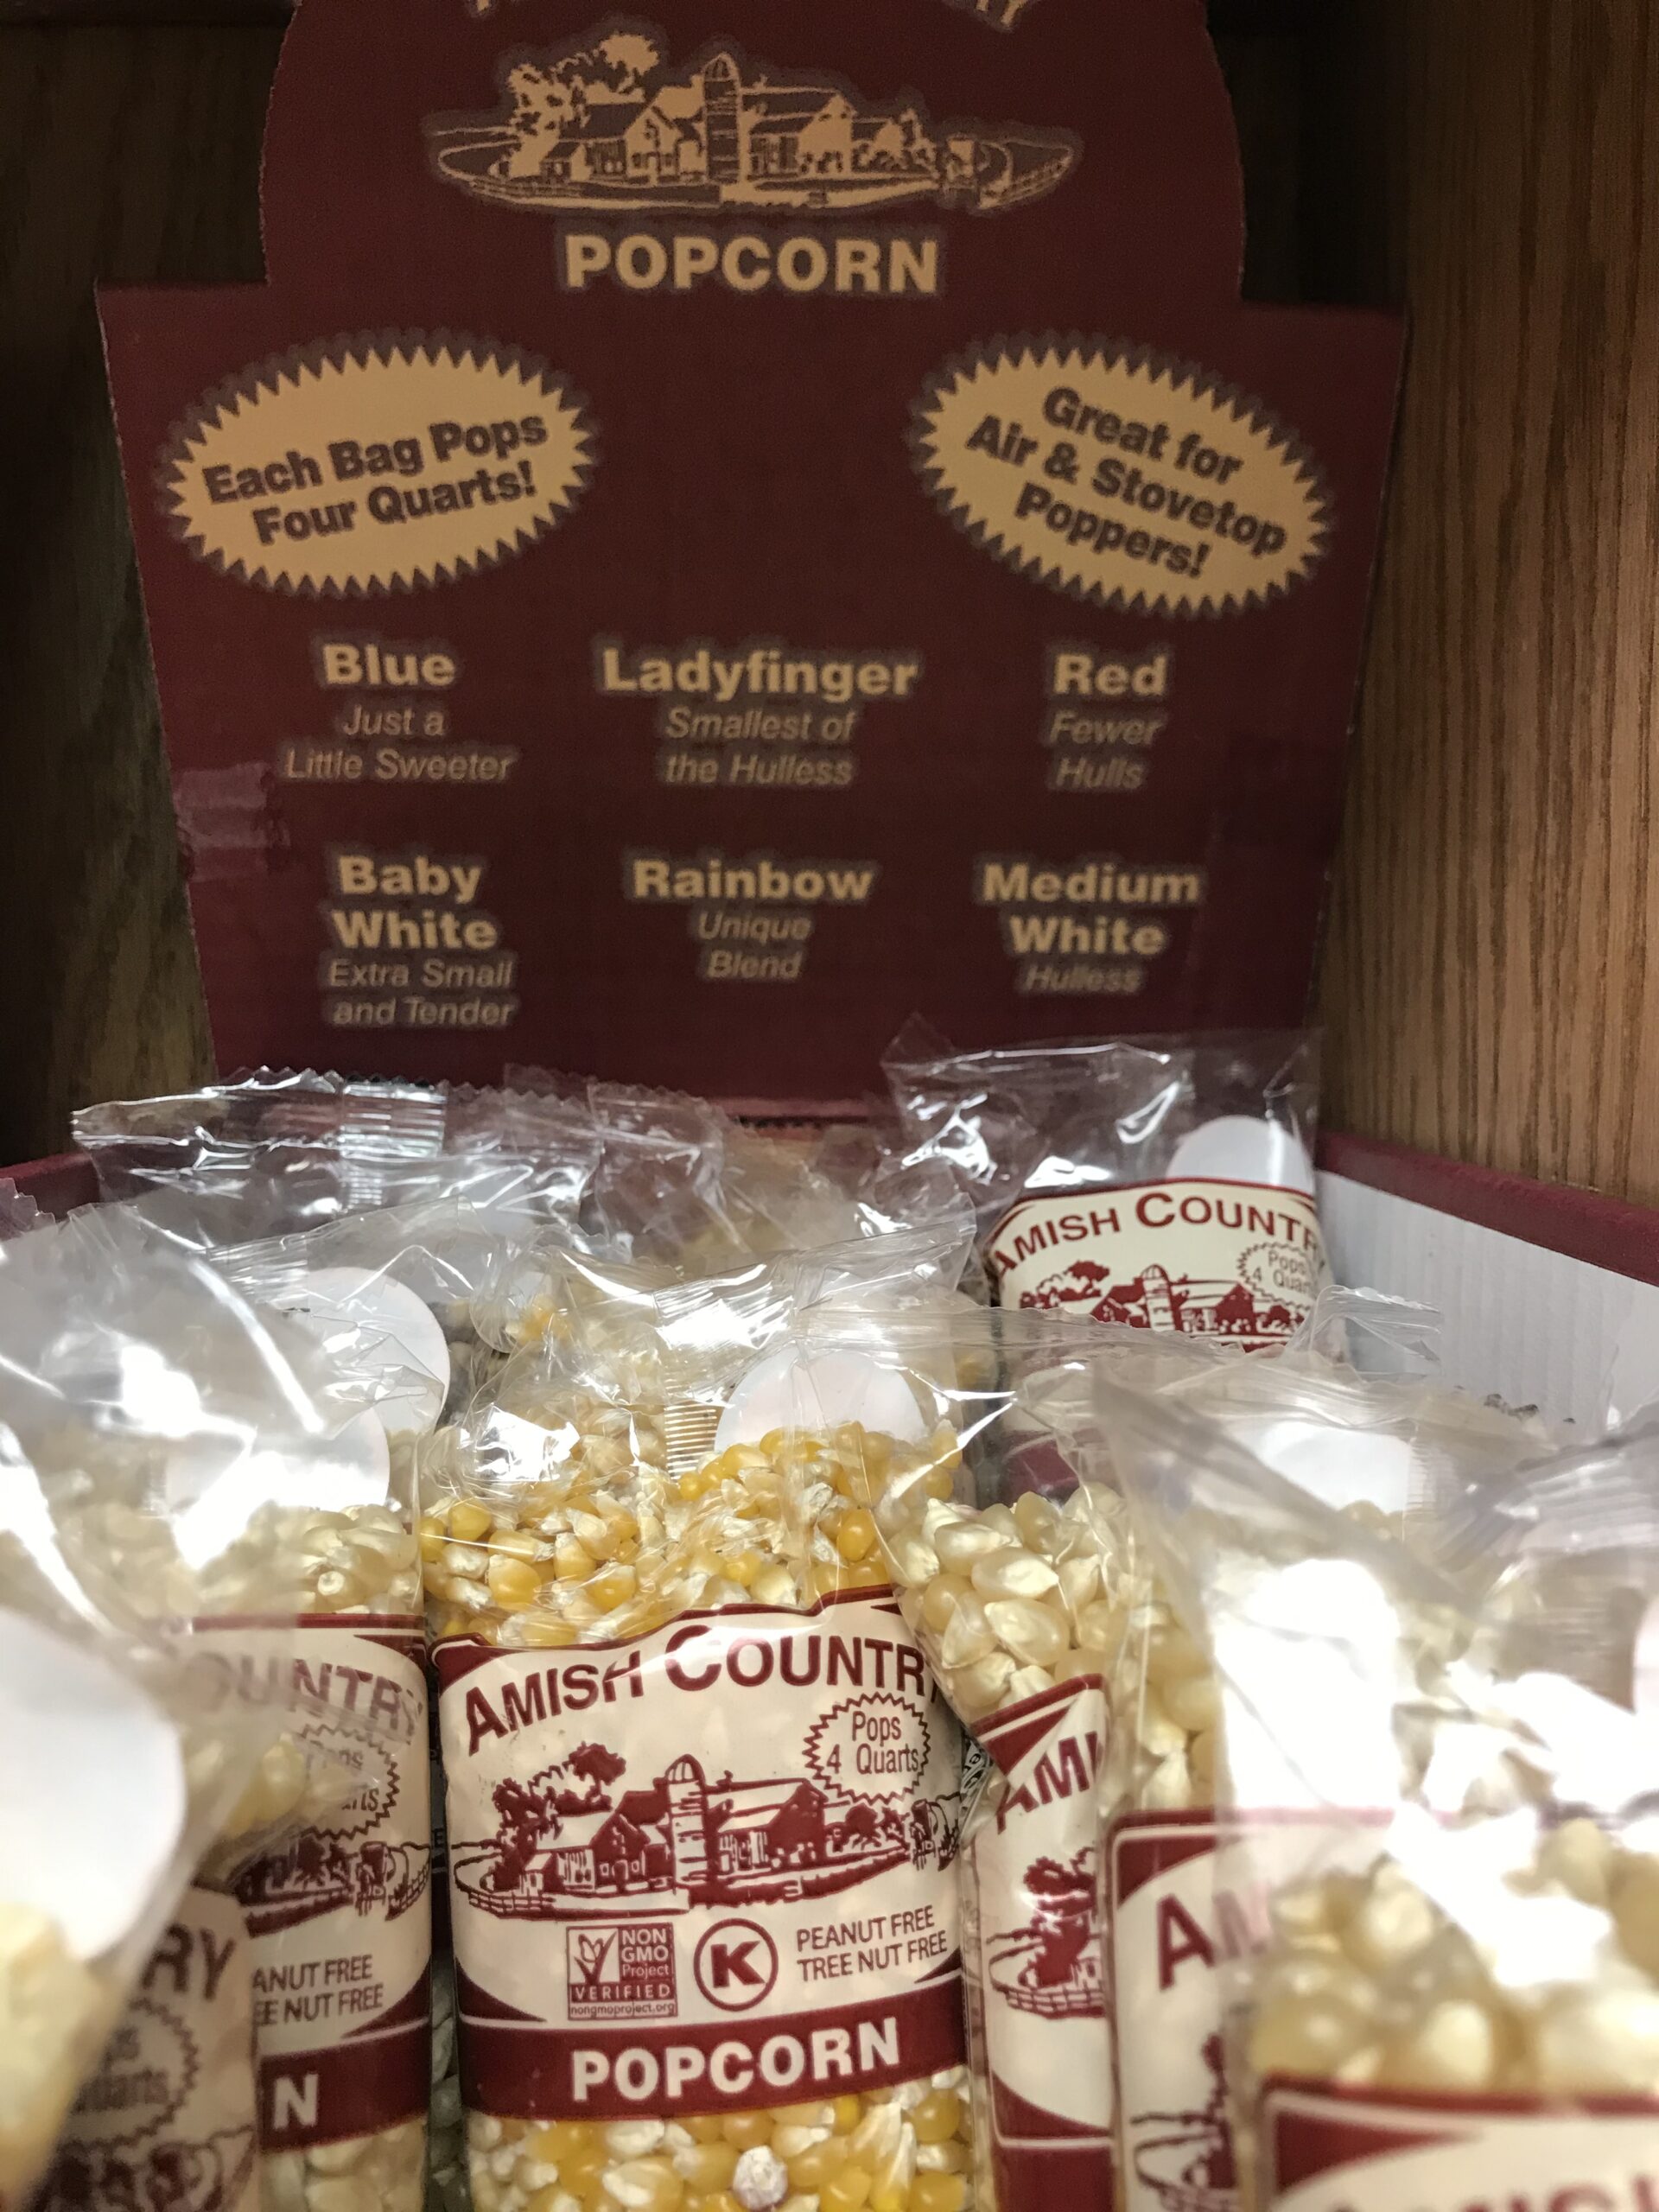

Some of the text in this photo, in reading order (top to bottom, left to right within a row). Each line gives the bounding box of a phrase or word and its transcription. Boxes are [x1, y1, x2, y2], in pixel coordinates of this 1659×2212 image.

[566, 234, 938, 294] POPCORN
[1042, 386, 1243, 486] Great for
[201, 415, 550, 505] Each Bag Pops
[253, 461, 537, 545] Four Quarts!
[964, 414, 1287, 559] Air & Stovetop
[1014, 481, 1212, 579] Poppers!
[322, 643, 456, 686] Blue
[603, 648, 919, 703] Ladyfinger
[1053, 653, 1167, 696] Red
[343, 704, 447, 736] Just a
[666, 706, 859, 742] Smallest of
[1048, 709, 1167, 746] Fewer
[284, 747, 514, 781] Little Sweeter
[665, 754, 854, 785] the Hulless
[1056, 757, 1145, 790] Hulls
[338, 855, 482, 904] Baby
[632, 858, 875, 900] Rainbow
[982, 863, 1200, 904] Medium
[331, 910, 499, 950] White
[698, 911, 812, 944] Unique
[1009, 914, 1166, 955] White
[327, 958, 513, 989] Extra Small
[707, 949, 804, 981] Blend
[1024, 963, 1142, 995] Hulless
[332, 996, 516, 1027] and Tender
[990, 1192, 1325, 1279] AMISH COUNTR
[1252, 1266, 1263, 1282] 4
[466, 1649, 644, 1758] AMISH
[852, 1710, 901, 1747] Pops
[826, 1742, 919, 1776] 4 Quarts
[621, 1928, 668, 1945] NON
[797, 1904, 935, 1953] PEANUT FREE
[251, 1961, 321, 1993] ANUT
[323, 1954, 373, 1986] FREE
[621, 1945, 670, 1963] GMO
[622, 1963, 670, 1980] Project
[710, 1940, 768, 1989] K
[797, 1929, 948, 1983] TREE NUT FREE
[283, 1992, 334, 2024] NUT
[338, 1981, 385, 2016] FREE
[569, 2002, 676, 2019] nongmoproject.org
[575, 1984, 671, 2001] VERIFIED
[572, 2016, 900, 2102] POPCORN
